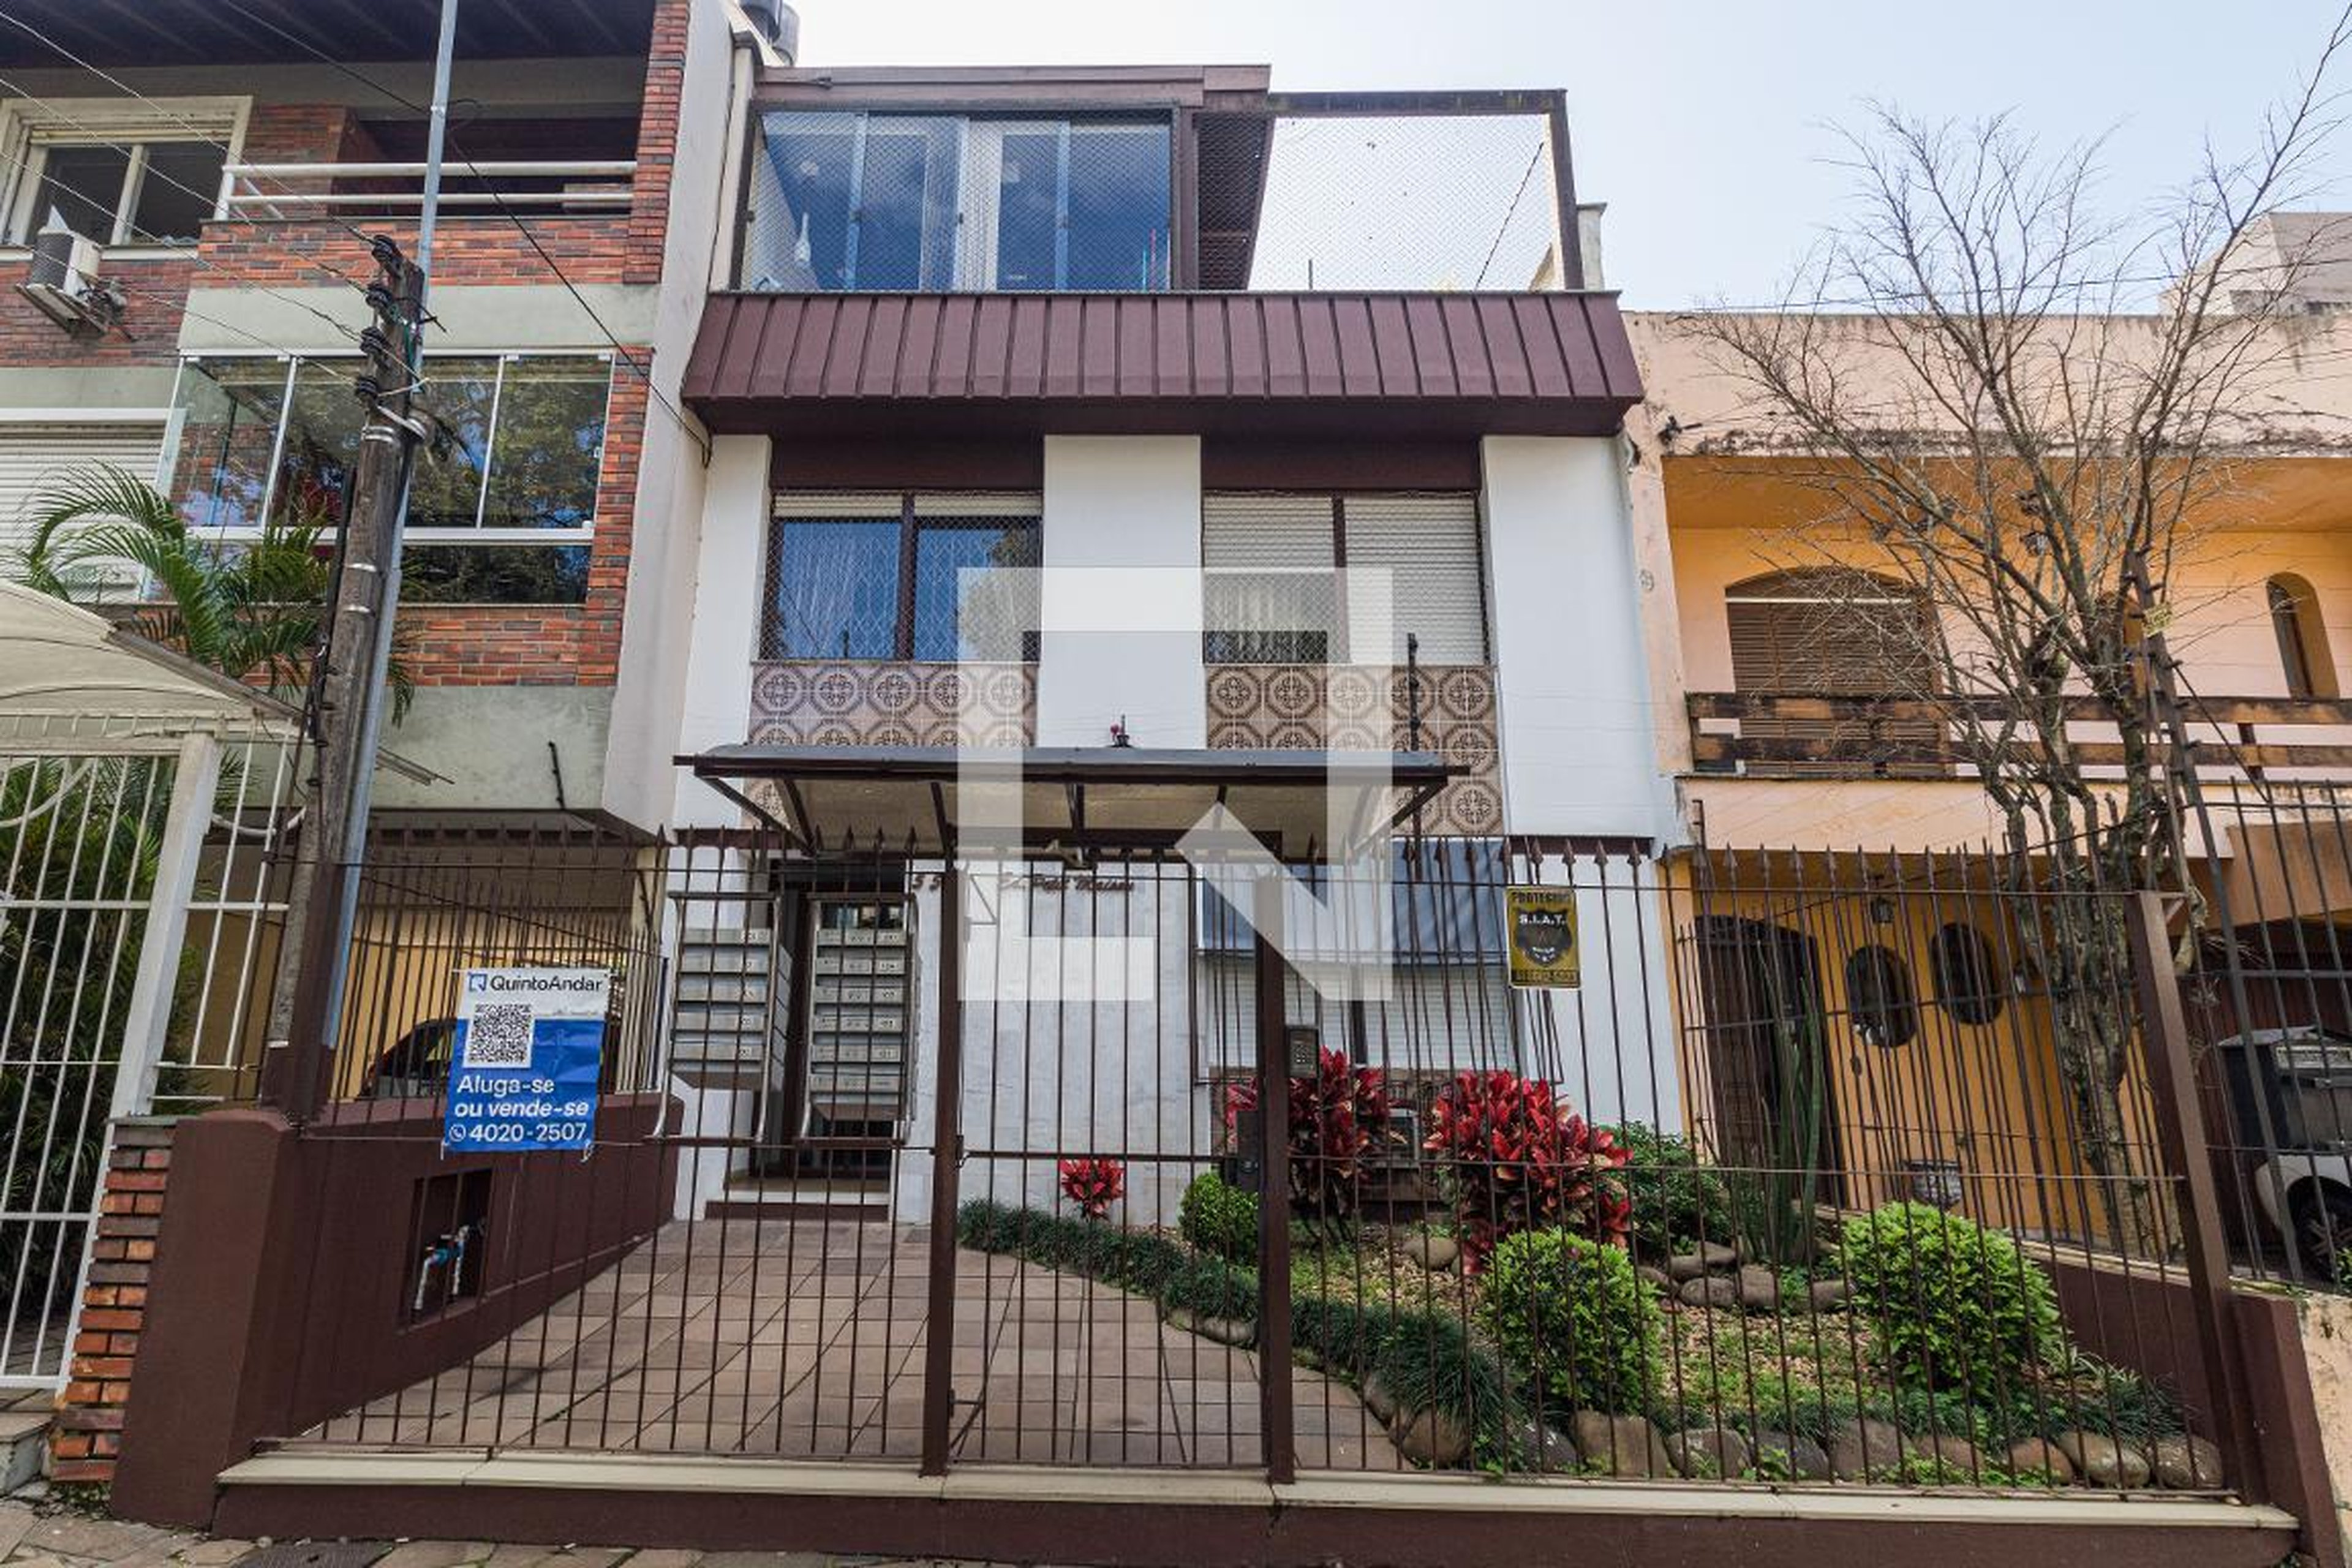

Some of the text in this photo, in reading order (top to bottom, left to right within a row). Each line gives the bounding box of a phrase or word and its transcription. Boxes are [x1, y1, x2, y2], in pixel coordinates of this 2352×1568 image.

[491, 974, 602, 992] QuintoAndar
[457, 1075, 555, 1098] Aluga-se
[454, 1099, 589, 1117] ou vende-se
